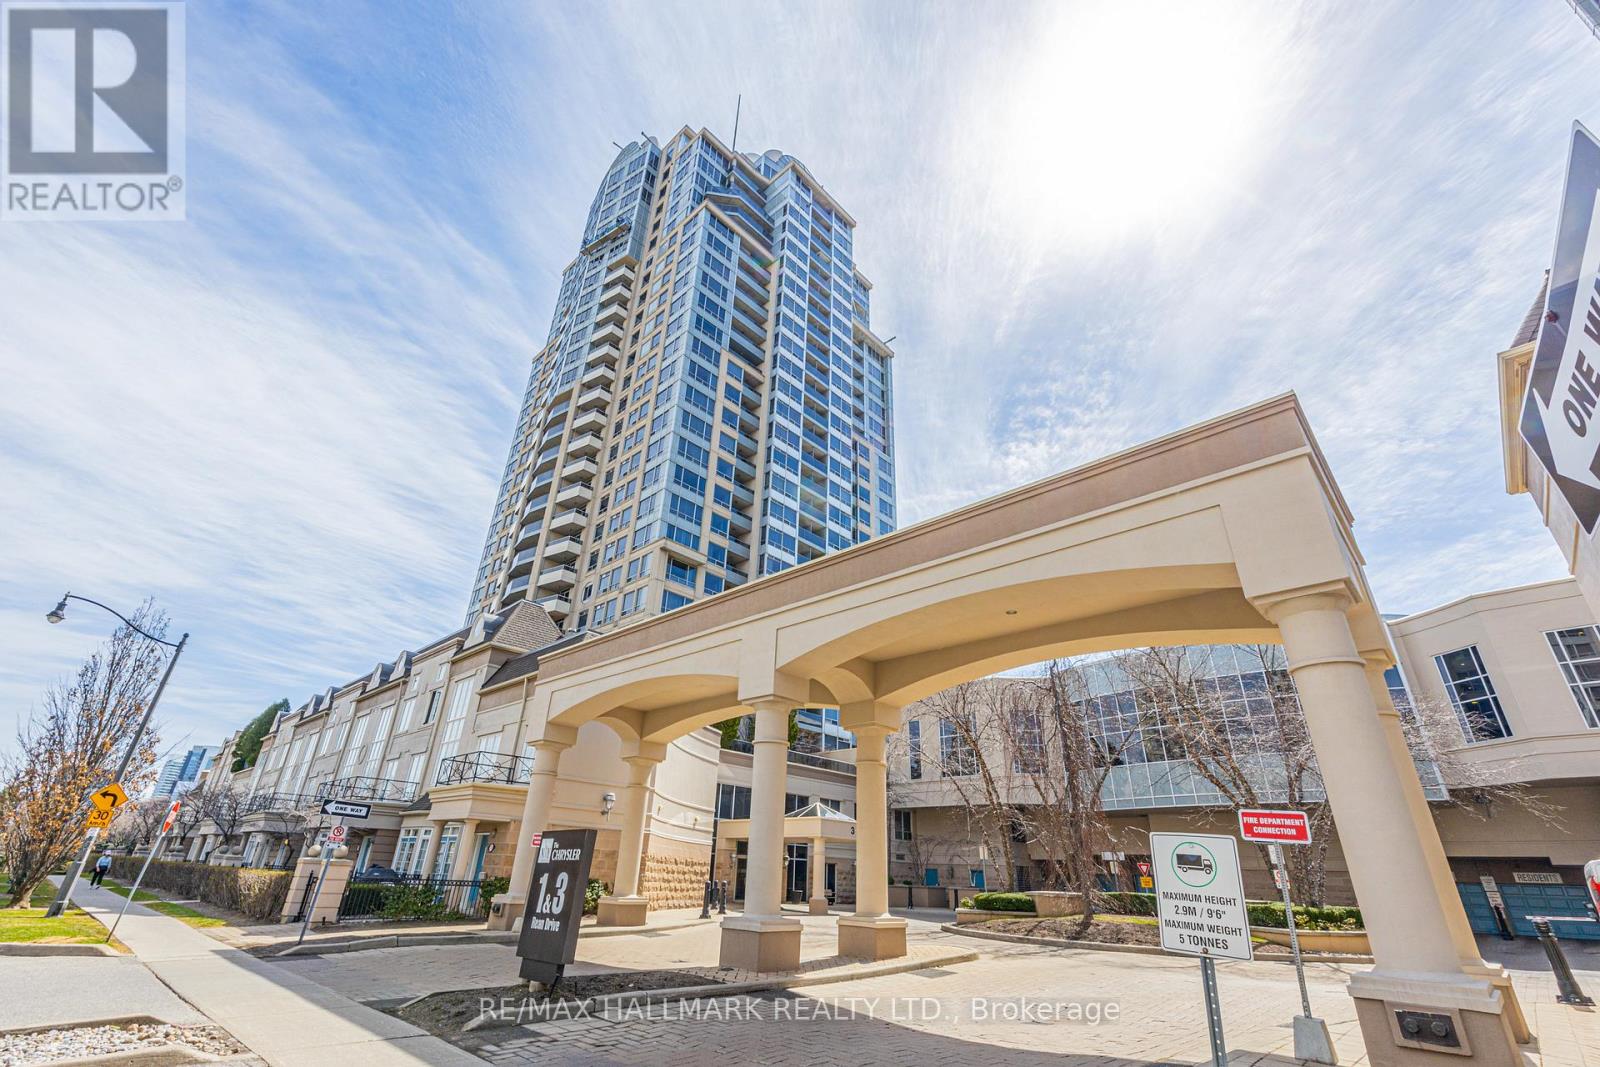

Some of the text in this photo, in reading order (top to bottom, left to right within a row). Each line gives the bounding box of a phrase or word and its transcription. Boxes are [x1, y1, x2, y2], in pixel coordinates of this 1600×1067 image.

[1563, 349, 1600, 438] ONE
[93, 810, 109, 820] 30
[1243, 816, 1304, 826] FIRE DEPARTMENT
[1253, 826, 1297, 835] CONNECTION
[551, 848, 581, 861] CHRYSLER
[1516, 873, 1559, 882] RESIDENTS
[536, 872, 569, 914] 1&3
[1162, 891, 1237, 906] MAXIMUM HEIGHT
[1174, 904, 1197, 916] 2.9M
[1199, 908, 1204, 918] /
[1164, 919, 1243, 937] MAXIMUM WEIGHT
[1179, 934, 1229, 950] 5 TONNES
